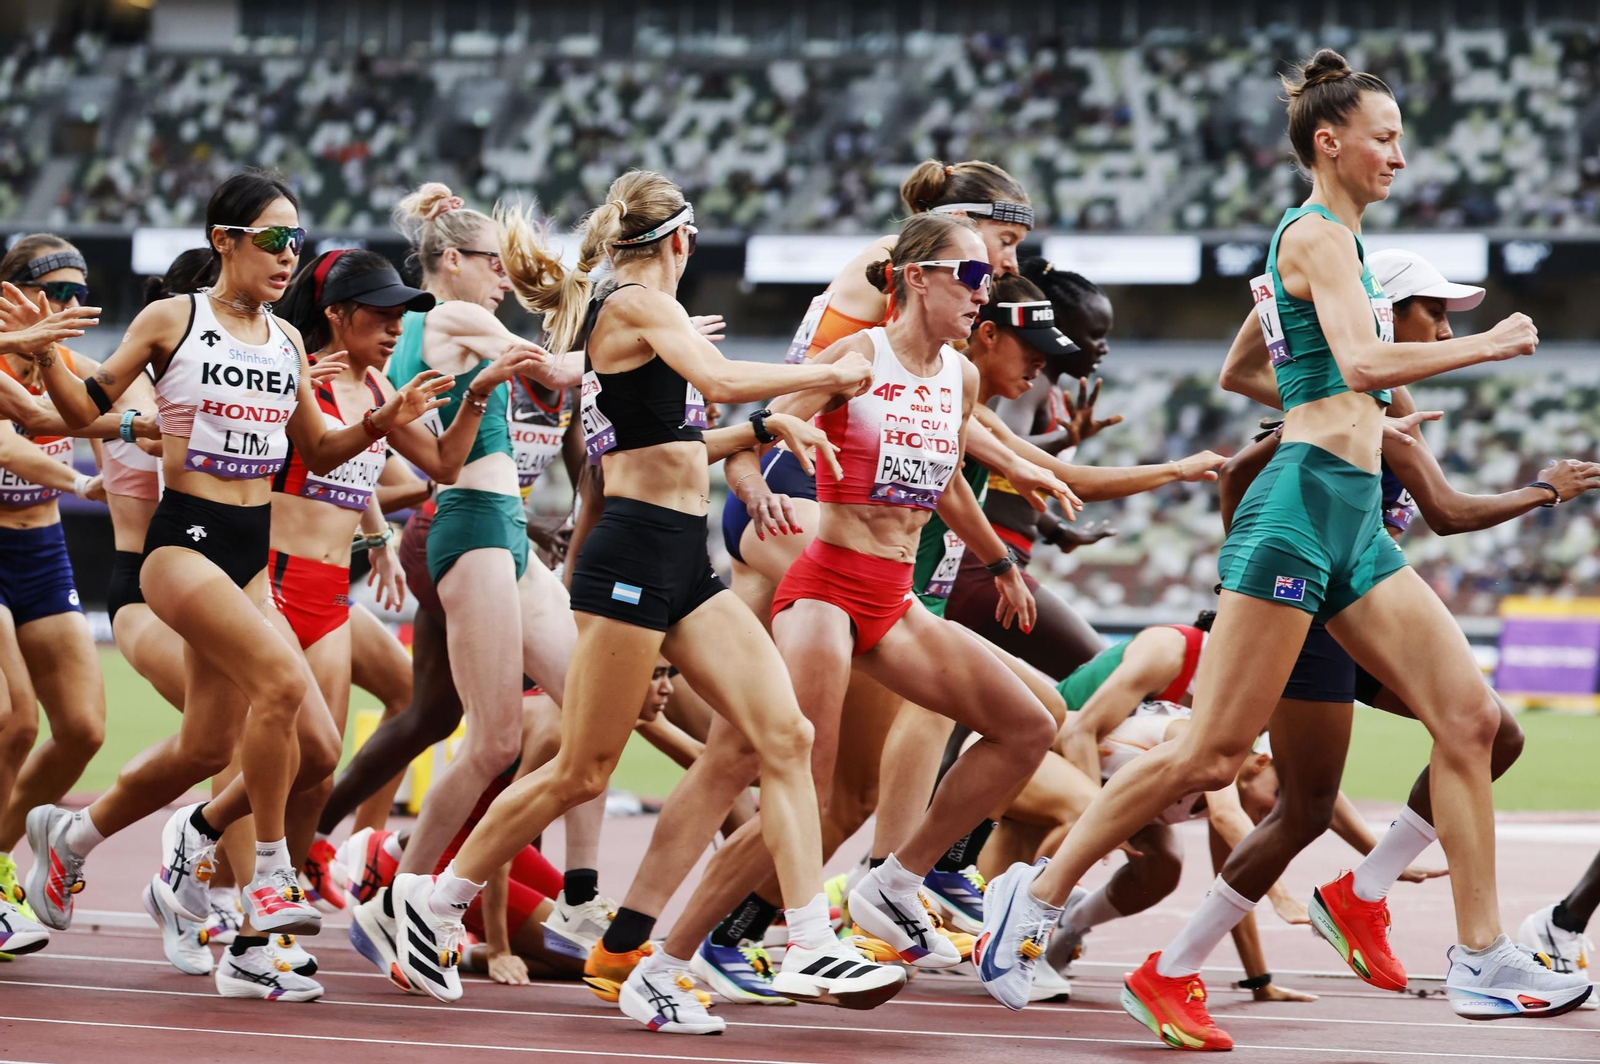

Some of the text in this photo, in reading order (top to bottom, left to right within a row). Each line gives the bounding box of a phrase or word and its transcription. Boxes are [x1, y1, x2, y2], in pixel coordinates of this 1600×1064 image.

[228, 348, 276, 366] Shinhan
[201, 362, 296, 395] KOREA
[873, 382, 906, 402] 4F
[200, 399, 290, 424] HONDA
[910, 404, 933, 413] ORLEN
[223, 430, 270, 457] LIM
[884, 429, 958, 455] HONDA
[215, 460, 282, 475] TOKYO25
